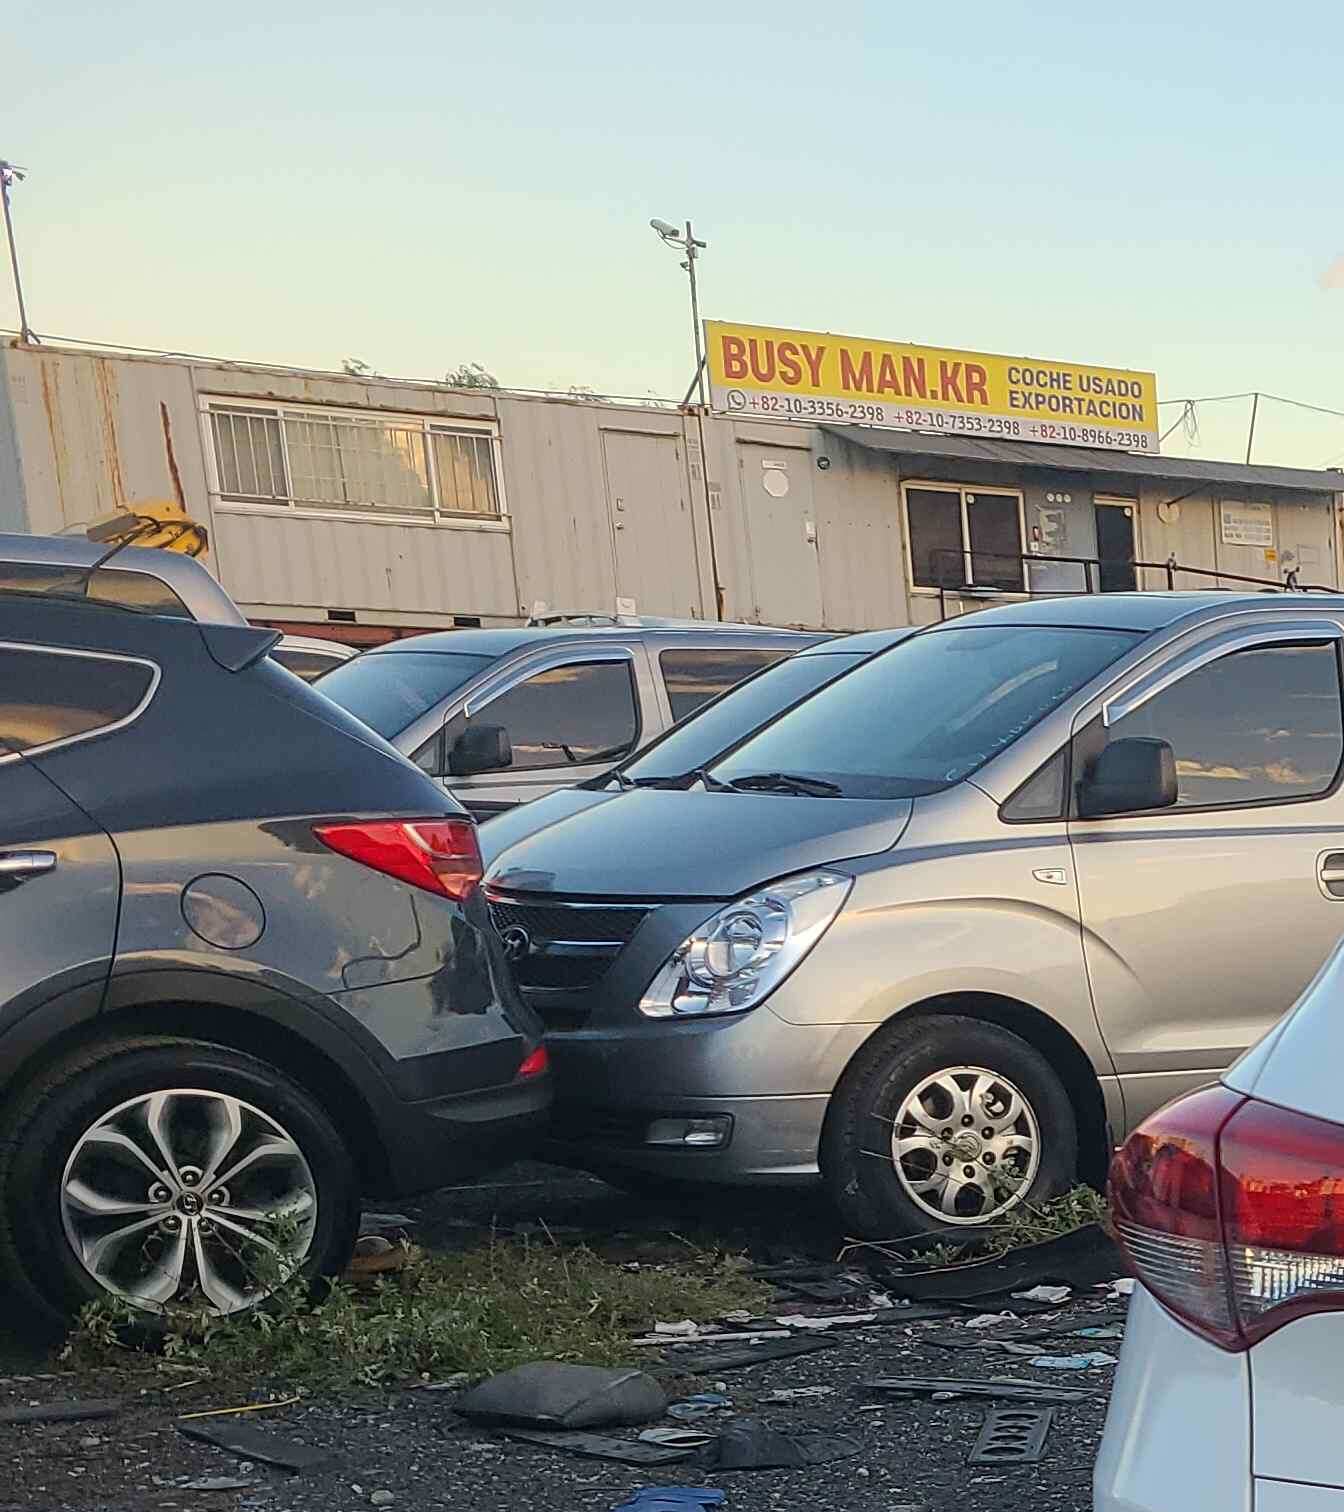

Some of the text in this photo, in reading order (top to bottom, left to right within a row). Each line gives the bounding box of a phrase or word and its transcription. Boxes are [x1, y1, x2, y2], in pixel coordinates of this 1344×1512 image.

[720, 334, 991, 406] BUSY MAN.KR
[1007, 366, 1143, 399] COCHE USADO
[750, 395, 1149, 449] +82-10-3356-2398 +82-10-7353-2398 +82-10-8966-2398
[1008, 389, 1145, 422] EXPORTACION
